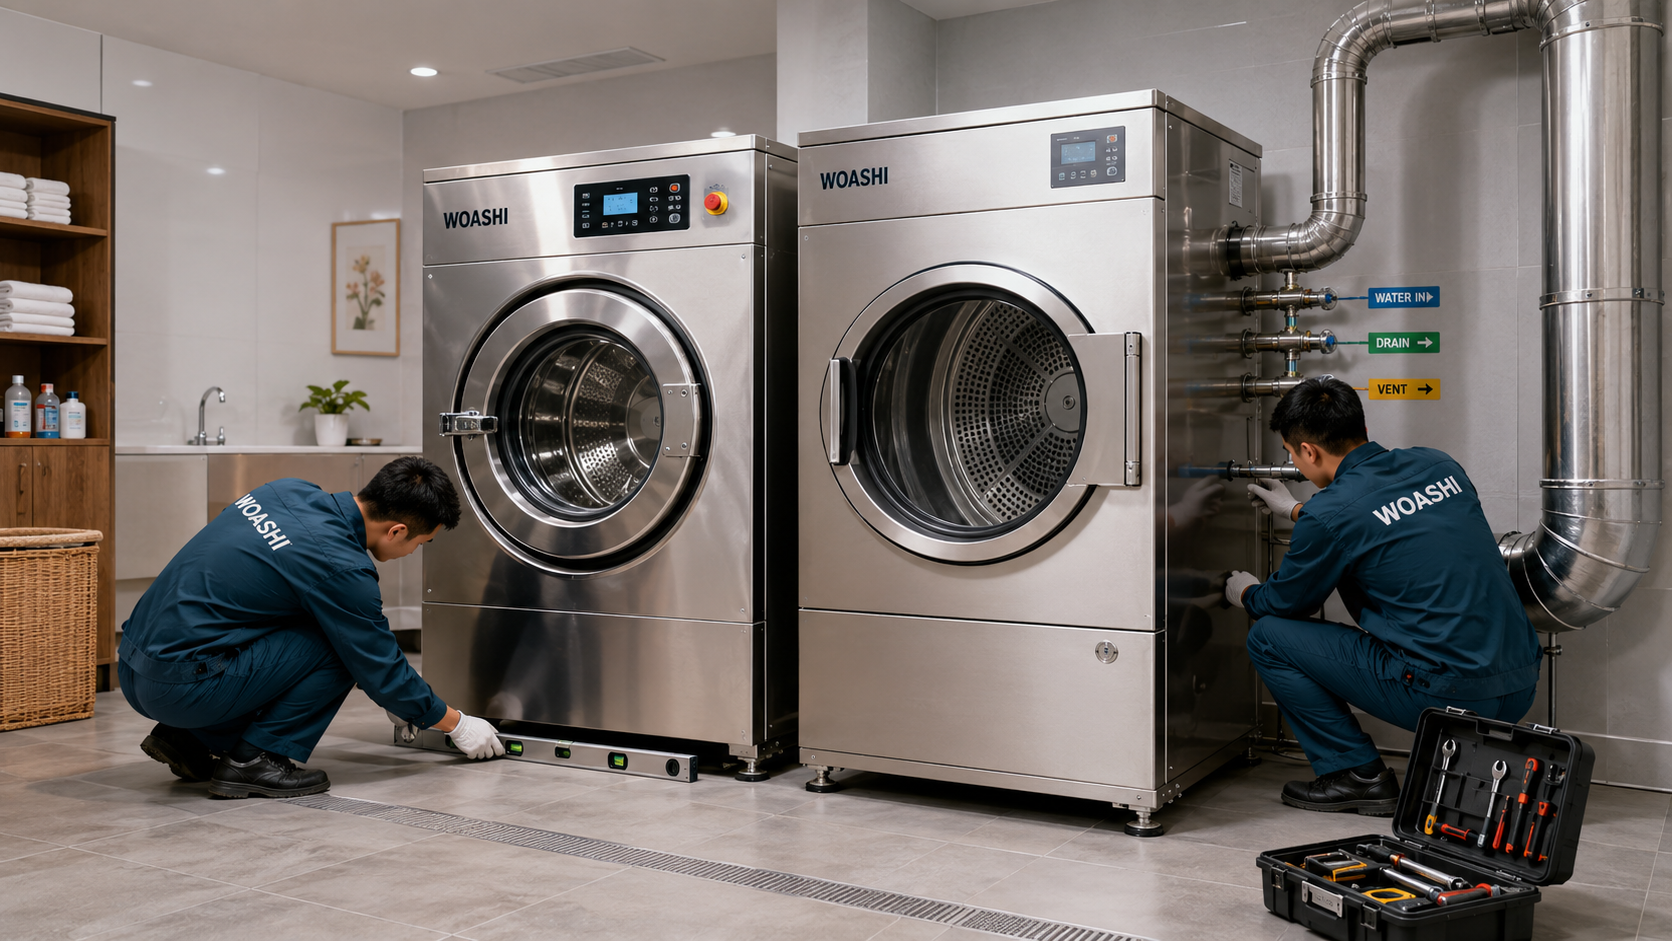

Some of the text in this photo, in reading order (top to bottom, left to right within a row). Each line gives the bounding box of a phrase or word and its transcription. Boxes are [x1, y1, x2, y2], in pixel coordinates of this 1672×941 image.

[820, 166, 888, 190] WOASHI
[443, 207, 508, 229] WOASHI
[1375, 292, 1426, 303] WATER IN
[1376, 337, 1410, 348] DRAIN
[1377, 384, 1408, 395] VENT
[1372, 475, 1463, 526] WOASHI
[234, 493, 291, 551] WOASHI
